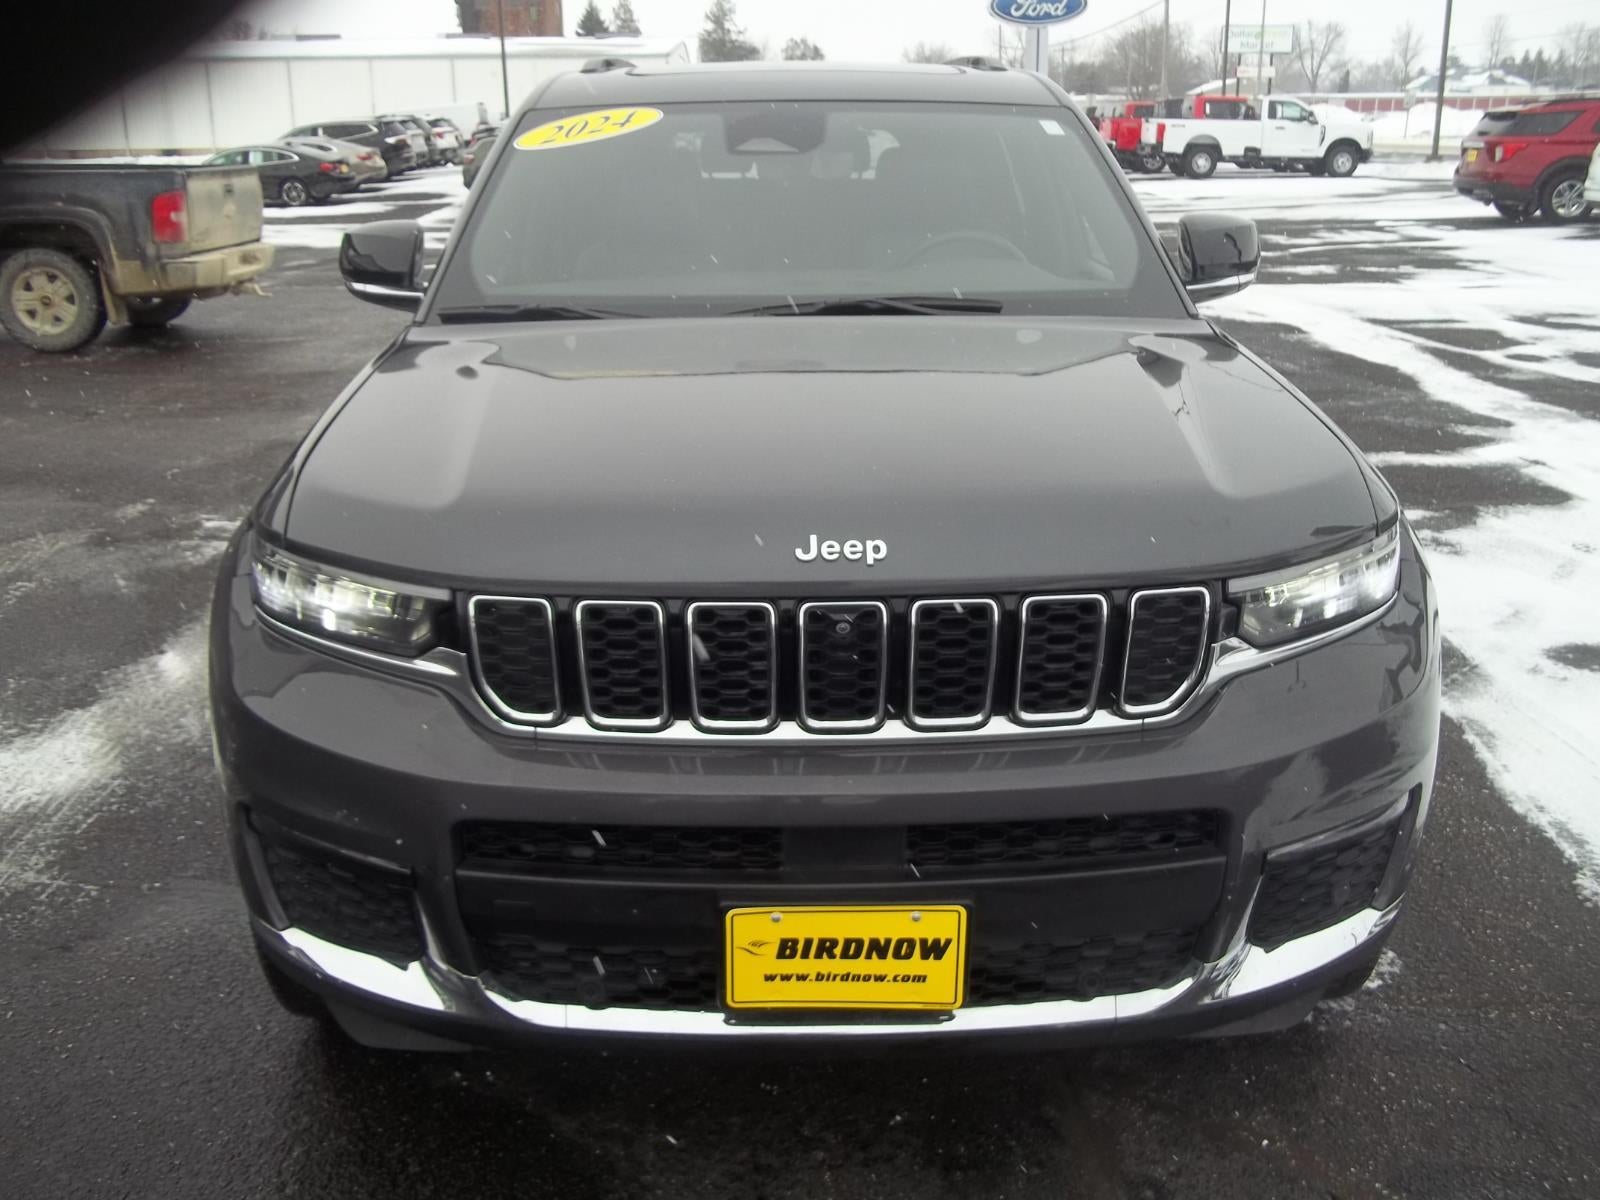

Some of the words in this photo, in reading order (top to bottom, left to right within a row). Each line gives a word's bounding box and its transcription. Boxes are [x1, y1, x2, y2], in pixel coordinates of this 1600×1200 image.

[1010, 0, 1067, 17] Ford
[540, 110, 637, 144] 2024
[794, 534, 888, 565] Jeep
[775, 937, 953, 961] BIRDNOW
[763, 971, 928, 983] www.birdnow.com
